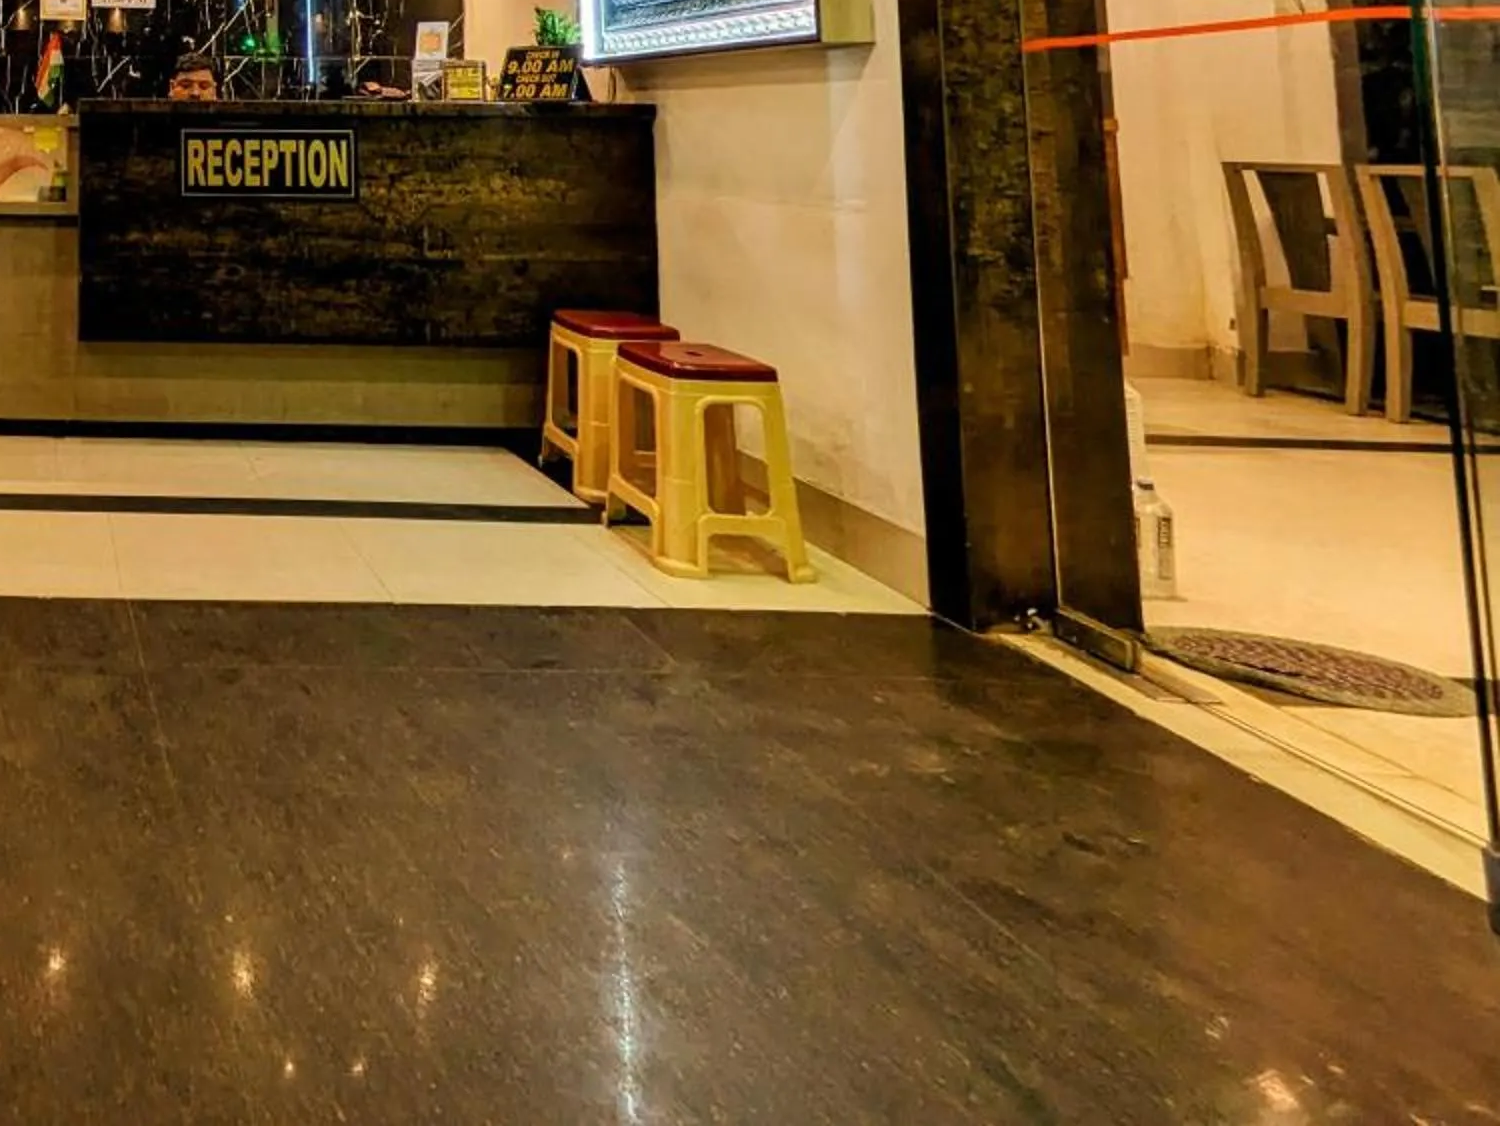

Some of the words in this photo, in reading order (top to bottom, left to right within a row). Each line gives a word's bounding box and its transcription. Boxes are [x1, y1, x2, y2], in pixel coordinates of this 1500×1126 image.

[507, 59, 543, 75] 9.00
[545, 58, 575, 73] AM
[503, 84, 535, 98] 7.00
[539, 83, 568, 98] AM
[187, 138, 349, 187] RECEPTION
